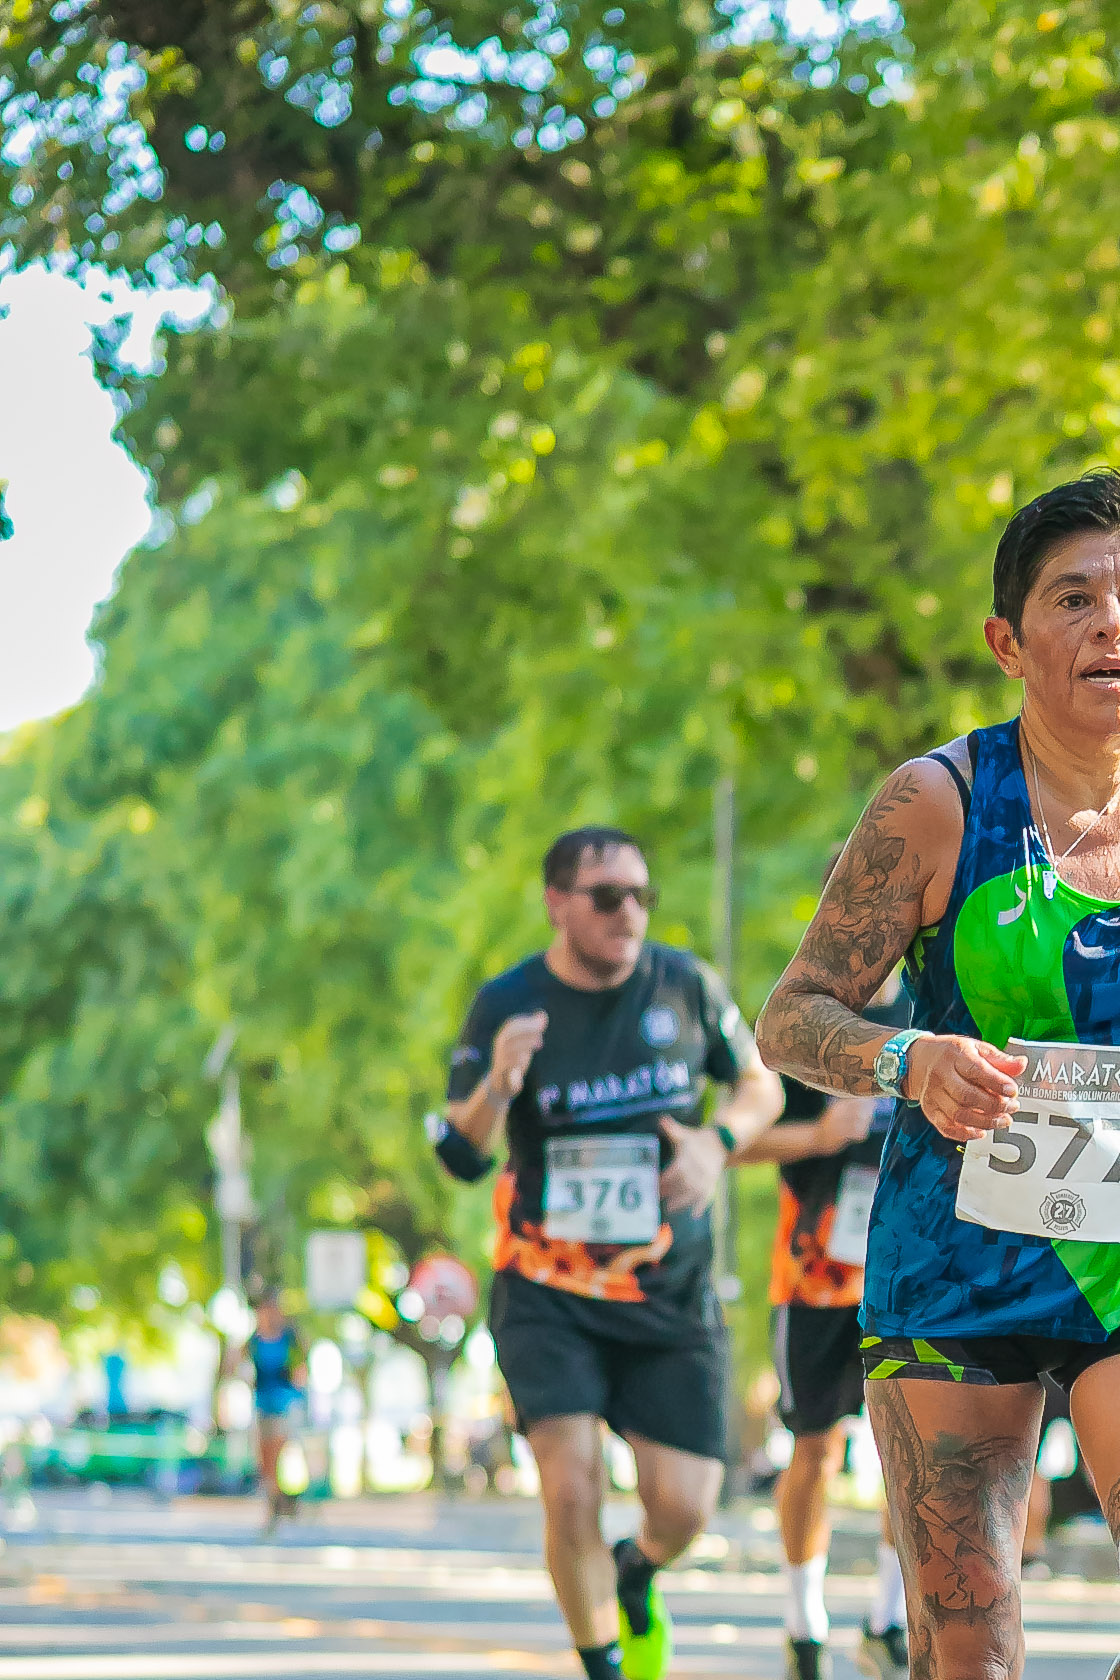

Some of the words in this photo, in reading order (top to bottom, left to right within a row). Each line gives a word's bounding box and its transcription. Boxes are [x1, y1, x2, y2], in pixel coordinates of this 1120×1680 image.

[1032, 1086, 1077, 1101] BOMBEROS
[565, 1177, 643, 1213] 376
[1053, 1201, 1074, 1219] 27
